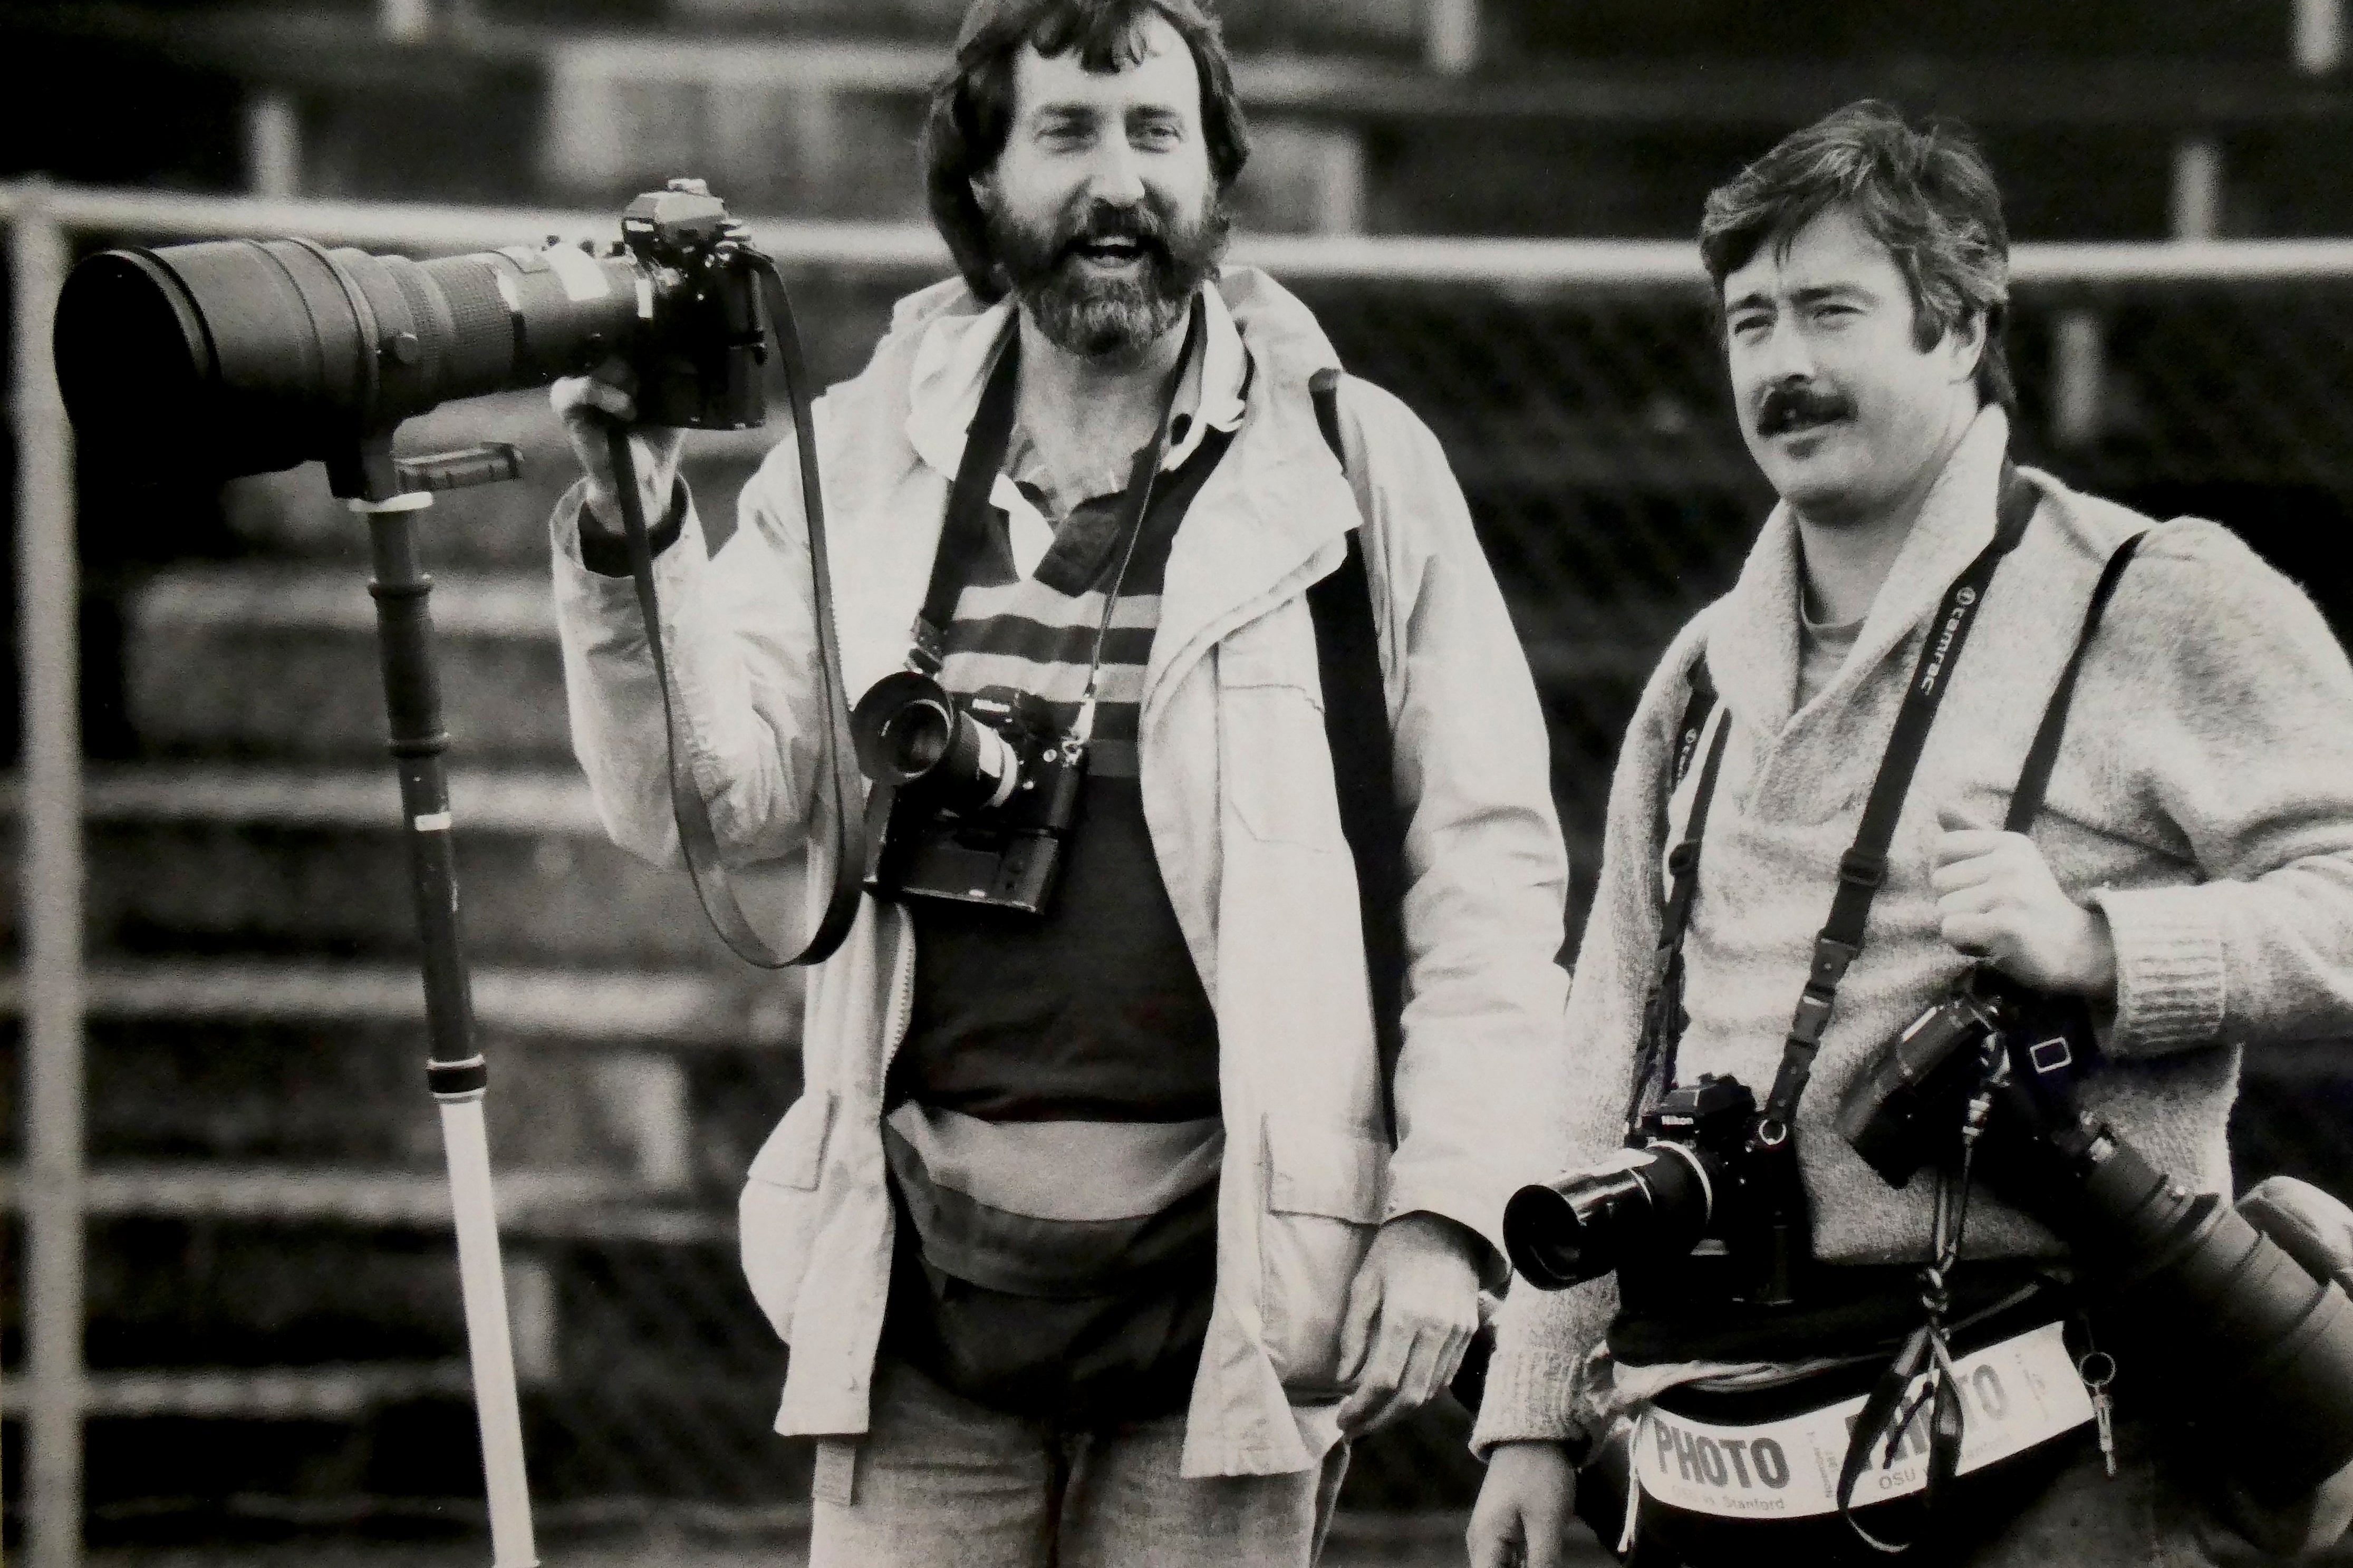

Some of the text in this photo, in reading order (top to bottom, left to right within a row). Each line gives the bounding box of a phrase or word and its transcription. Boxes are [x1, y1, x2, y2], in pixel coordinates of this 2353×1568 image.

[1654, 1417, 1790, 1489] PHOTO
[1878, 1467, 1916, 1490] OSU
[1722, 1495, 1786, 1510] Stanford
